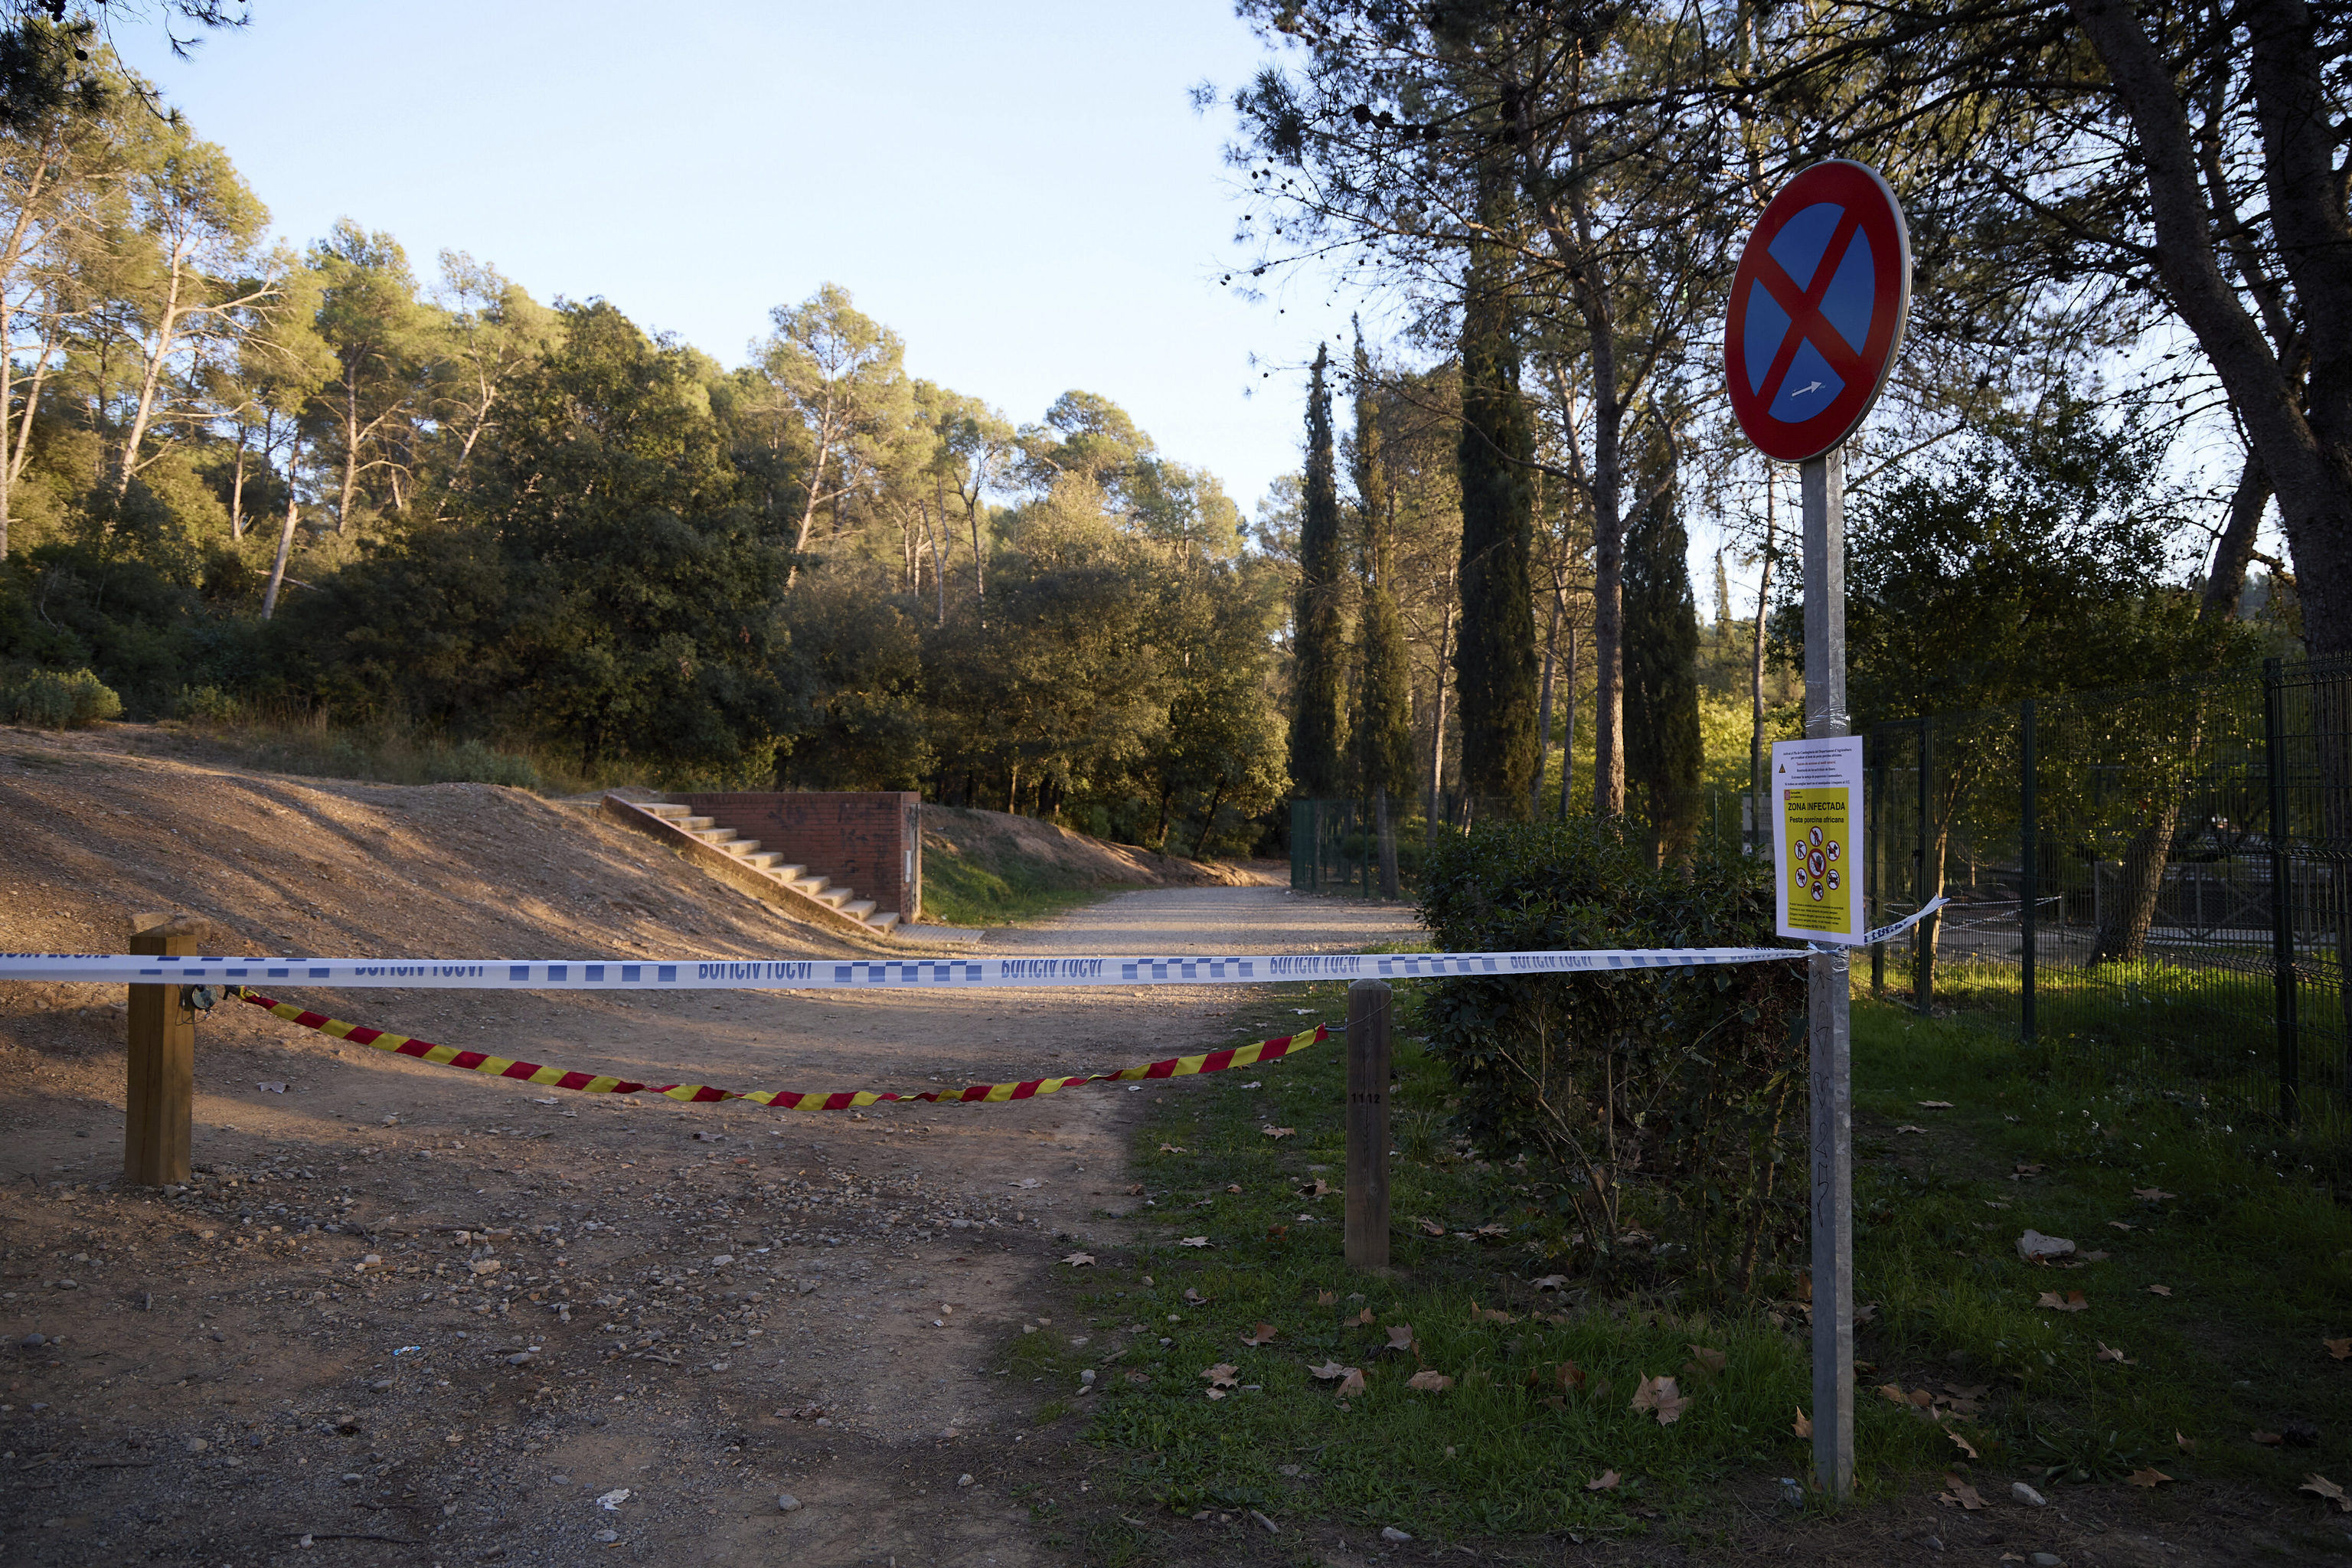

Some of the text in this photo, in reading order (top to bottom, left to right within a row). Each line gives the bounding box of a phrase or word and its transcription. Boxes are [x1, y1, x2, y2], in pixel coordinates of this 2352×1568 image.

[1788, 802, 1845, 811] ZONA INFECTADA
[1351, 1093, 1380, 1103] 1112
